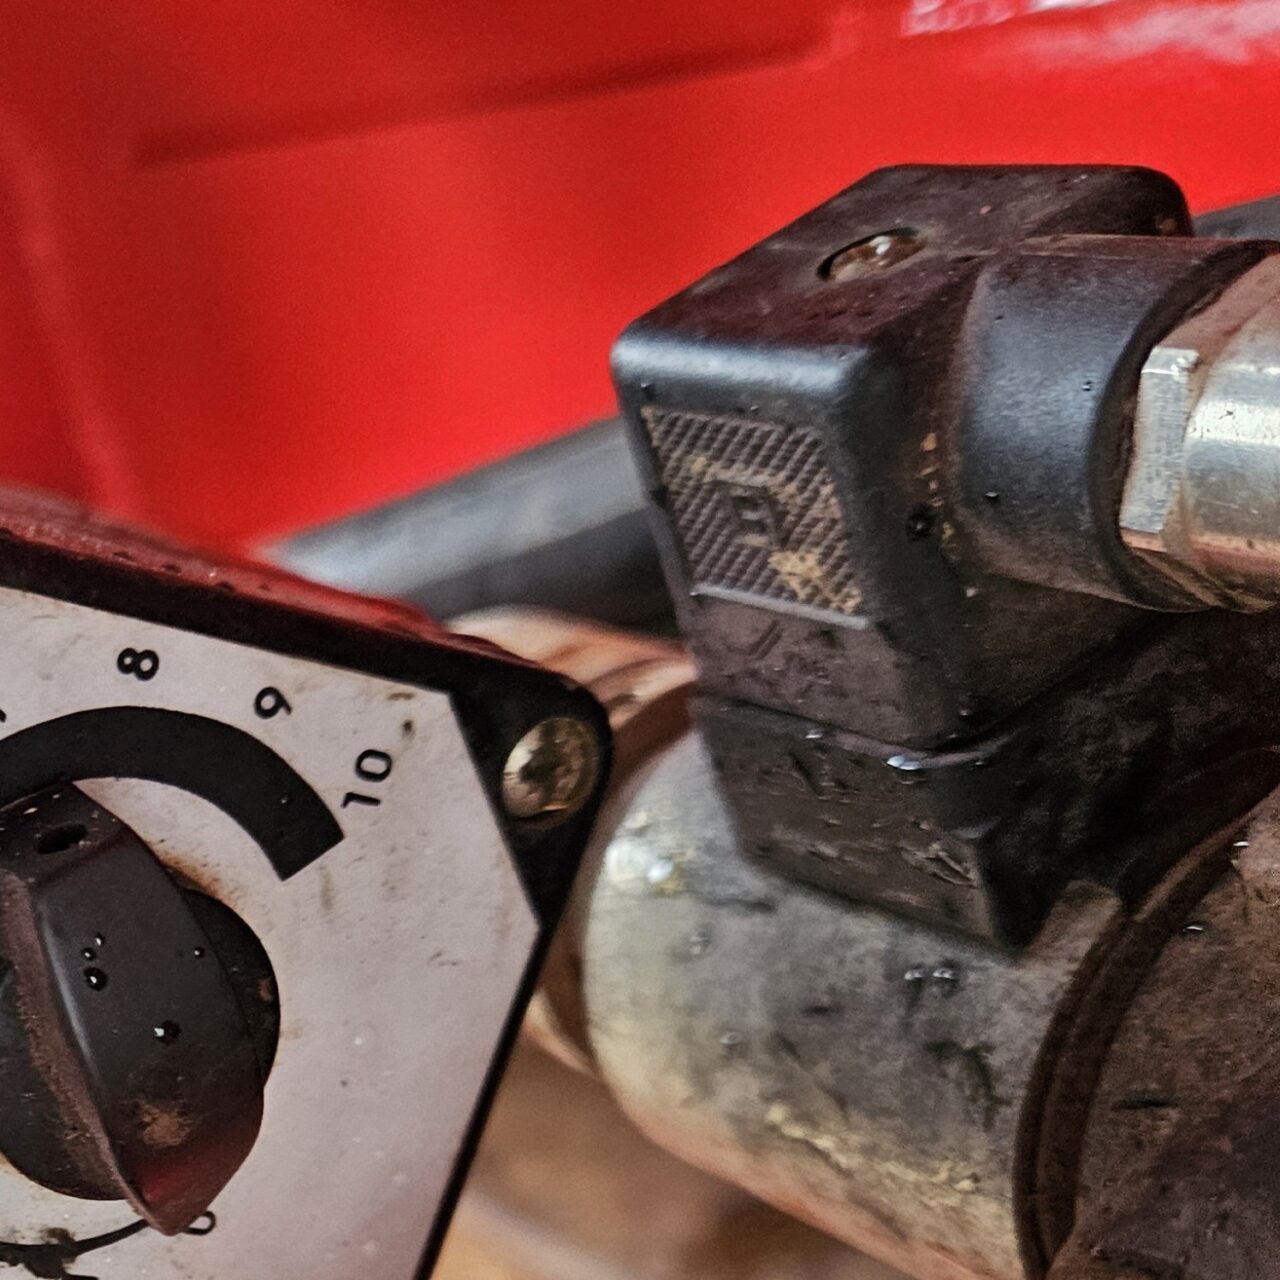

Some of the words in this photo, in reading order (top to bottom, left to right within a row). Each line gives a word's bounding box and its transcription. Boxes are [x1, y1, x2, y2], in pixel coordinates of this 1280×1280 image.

[117, 648, 160, 681] 8
[254, 687, 292, 719] 9
[341, 748, 394, 809] 10
